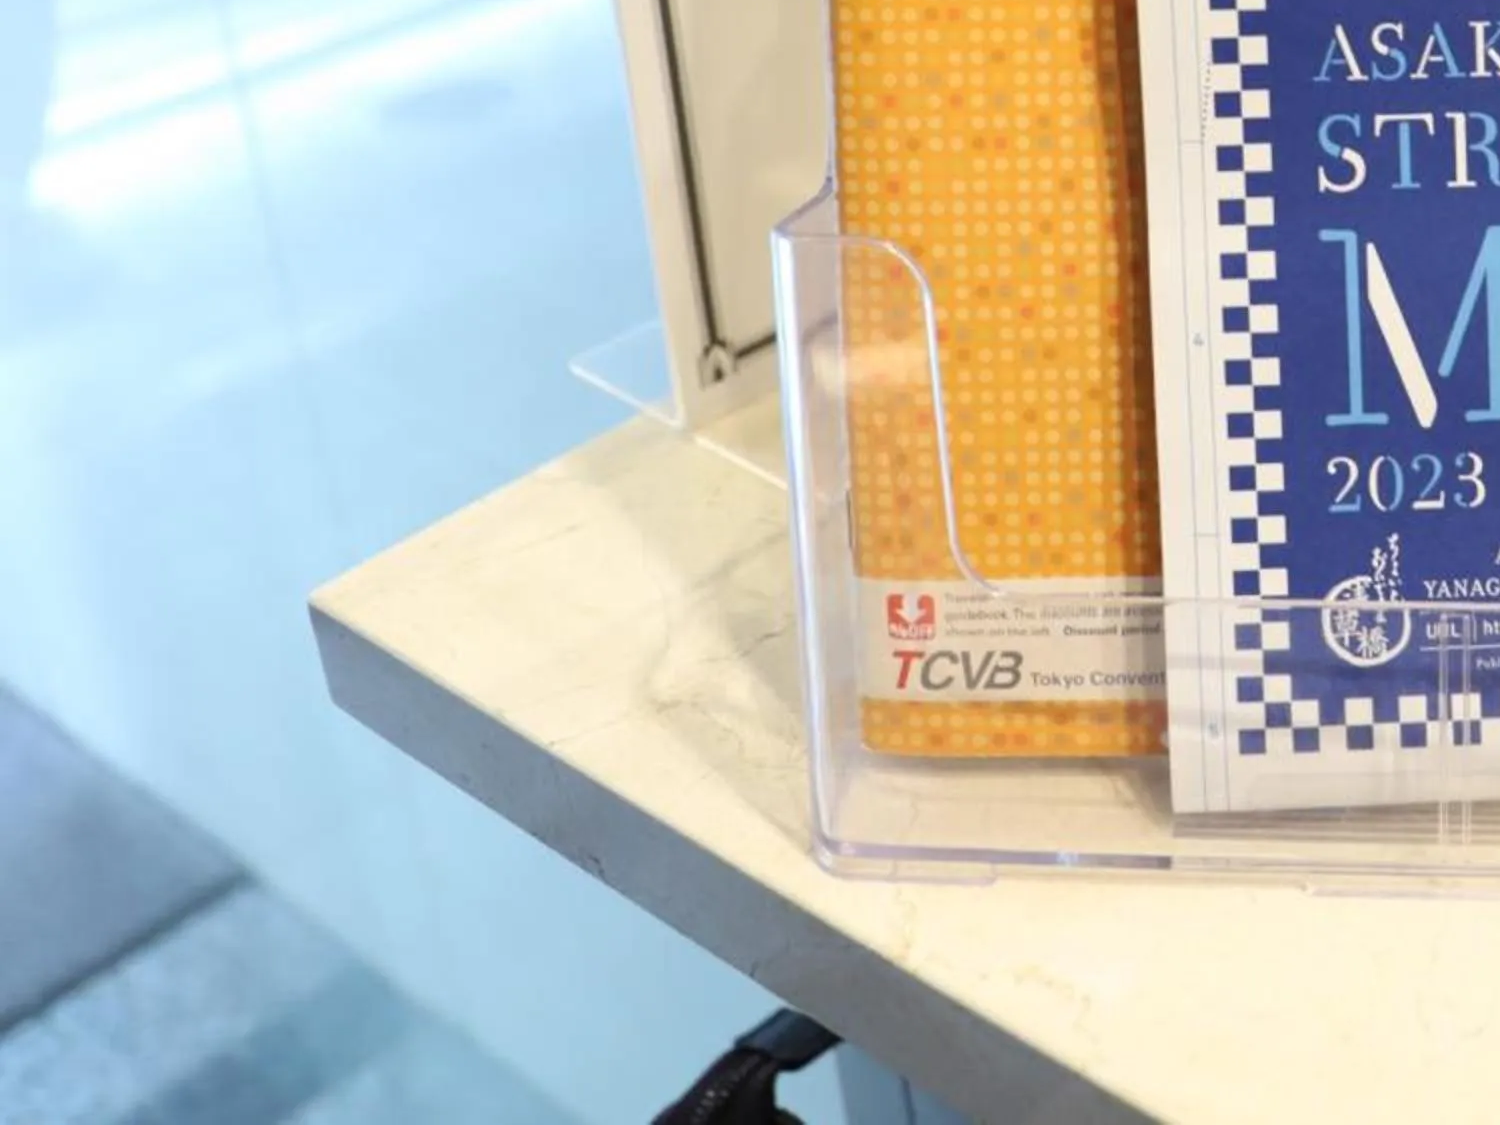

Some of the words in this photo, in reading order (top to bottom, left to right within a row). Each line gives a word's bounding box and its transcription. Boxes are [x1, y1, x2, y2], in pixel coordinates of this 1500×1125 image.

[1326, 451, 1488, 513] 2023
[893, 650, 1024, 691] TCVB
[1029, 670, 1085, 689] Tokyo
